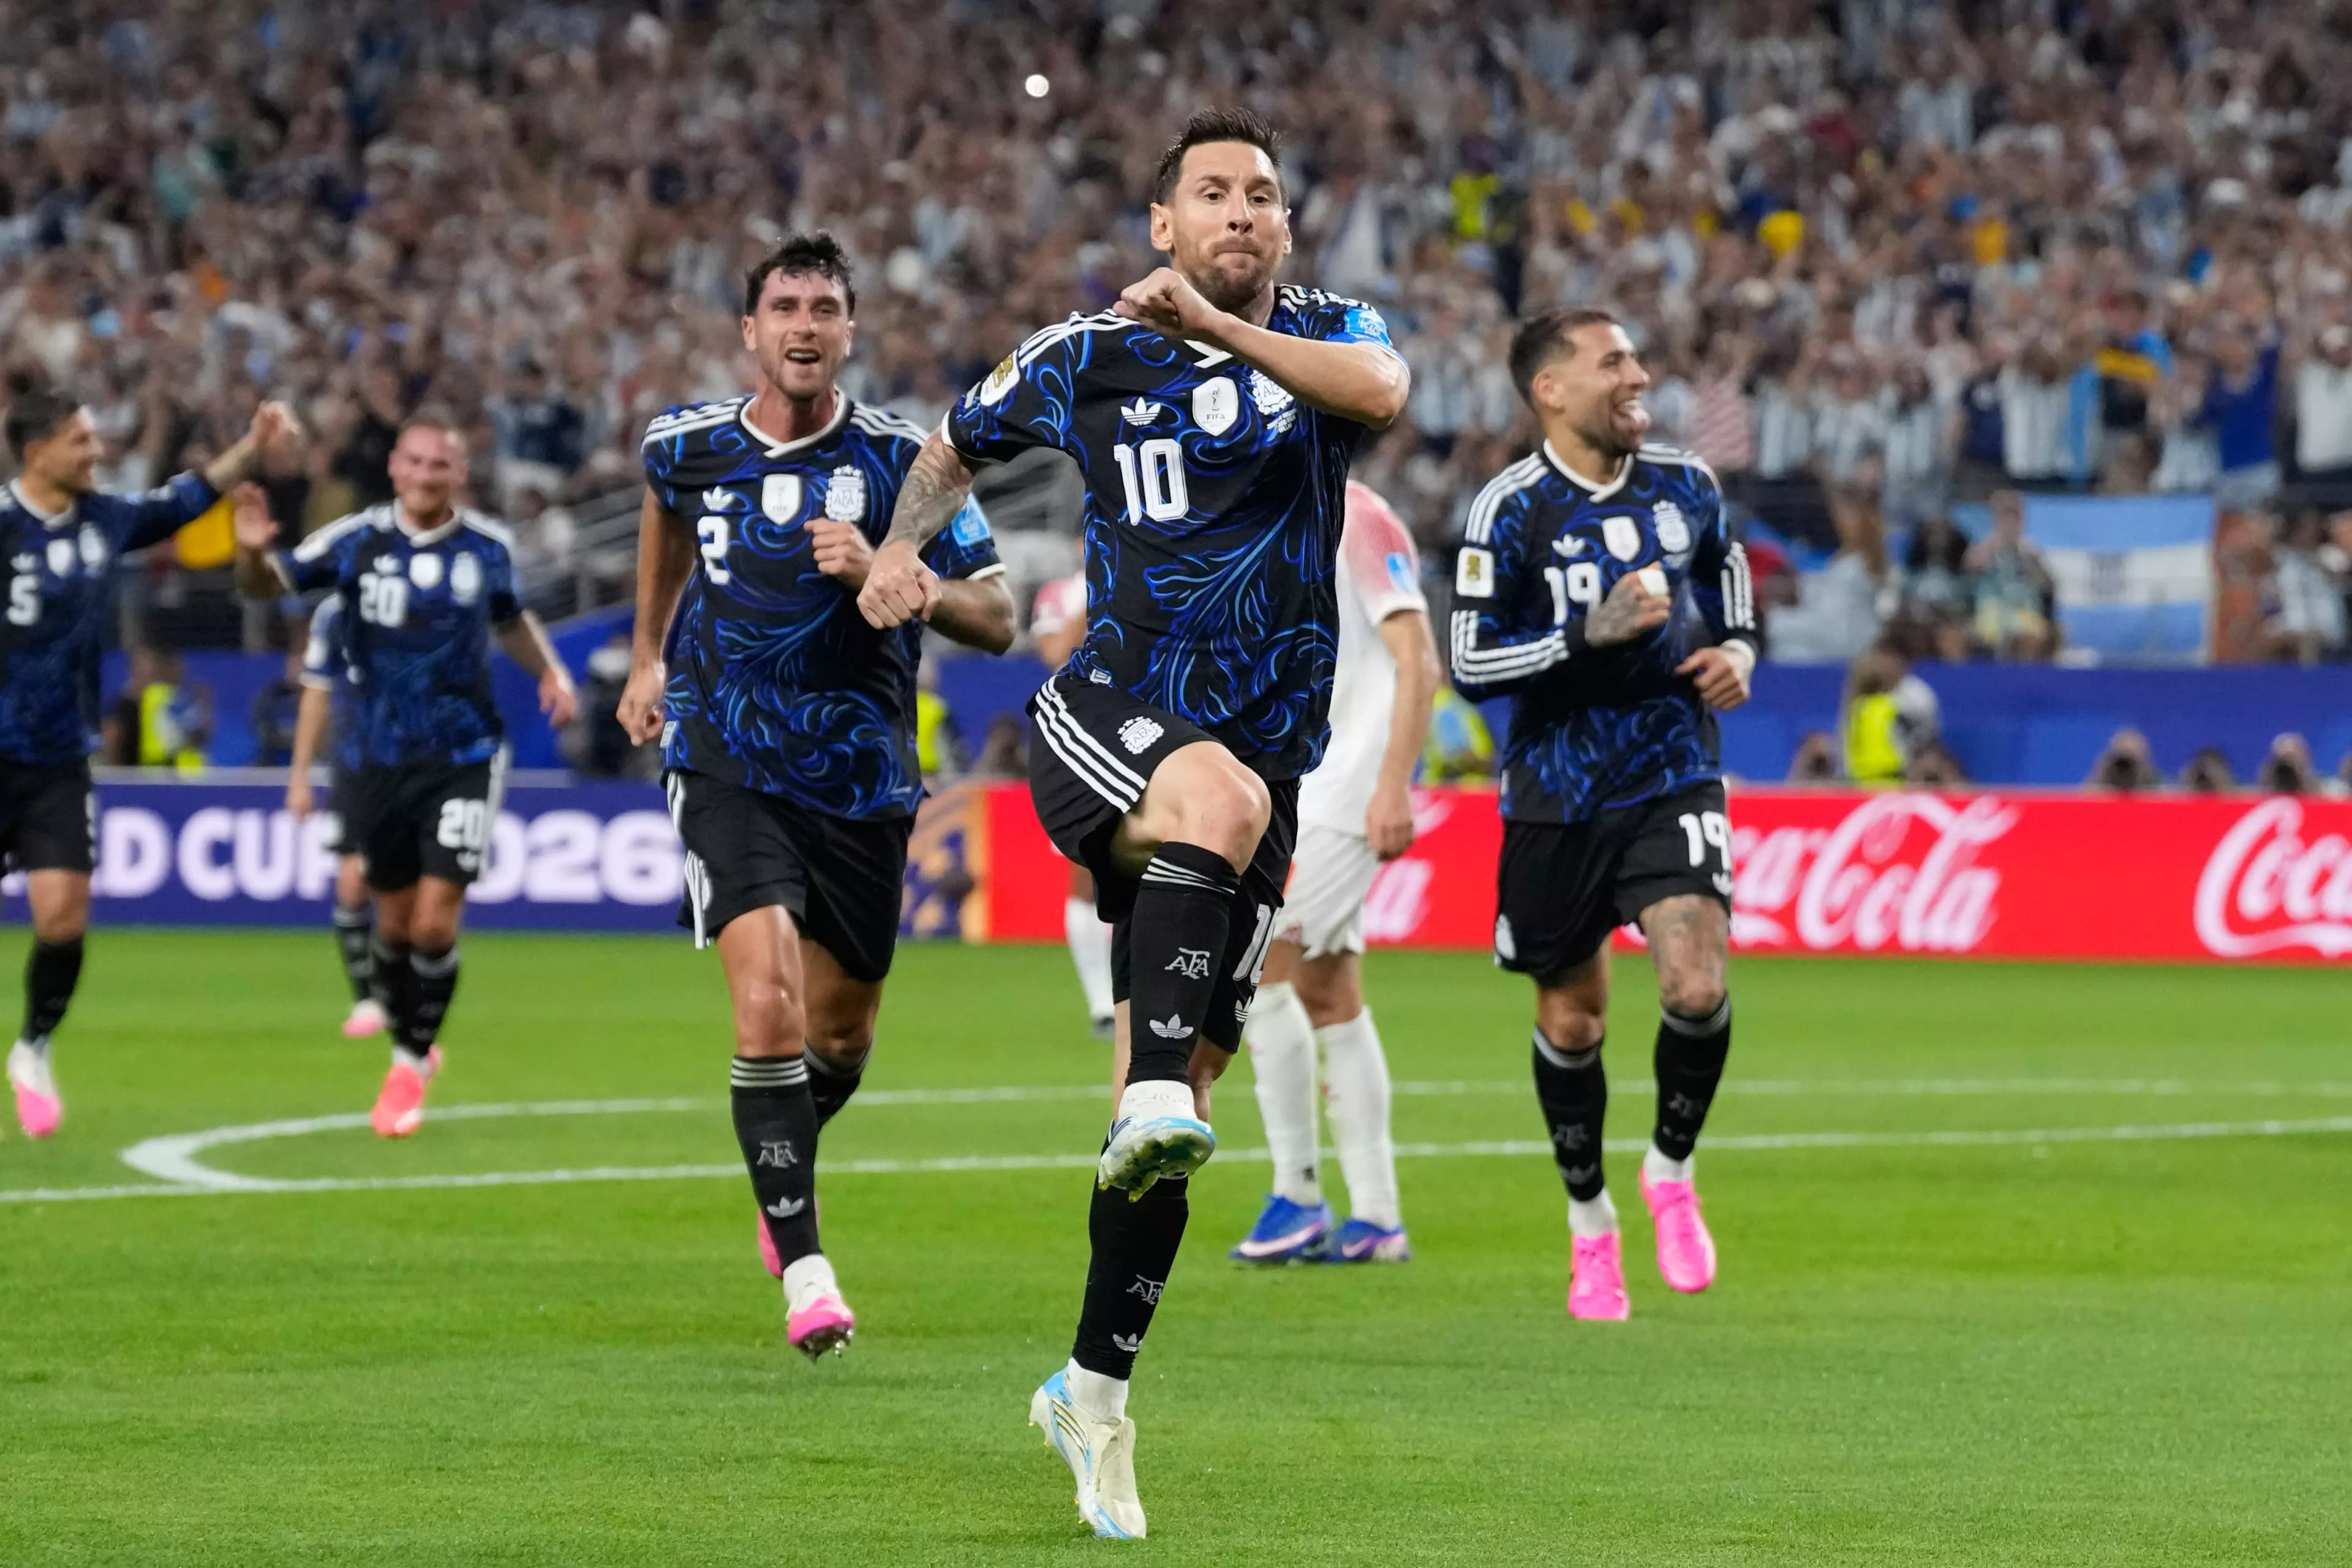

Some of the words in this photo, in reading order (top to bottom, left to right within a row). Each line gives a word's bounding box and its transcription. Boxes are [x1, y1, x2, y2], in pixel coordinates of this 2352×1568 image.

[1114, 439, 1189, 526] 10
[697, 516, 729, 585] 2
[7, 575, 40, 625] 5
[359, 572, 408, 628] 20
[1544, 562, 1601, 625] 19
[437, 798, 488, 851] 20
[1678, 810, 1730, 871] 19
[1164, 947, 1210, 979] AFA
[756, 1140, 797, 1168] AFA
[1126, 1274, 1164, 1305] AFA
